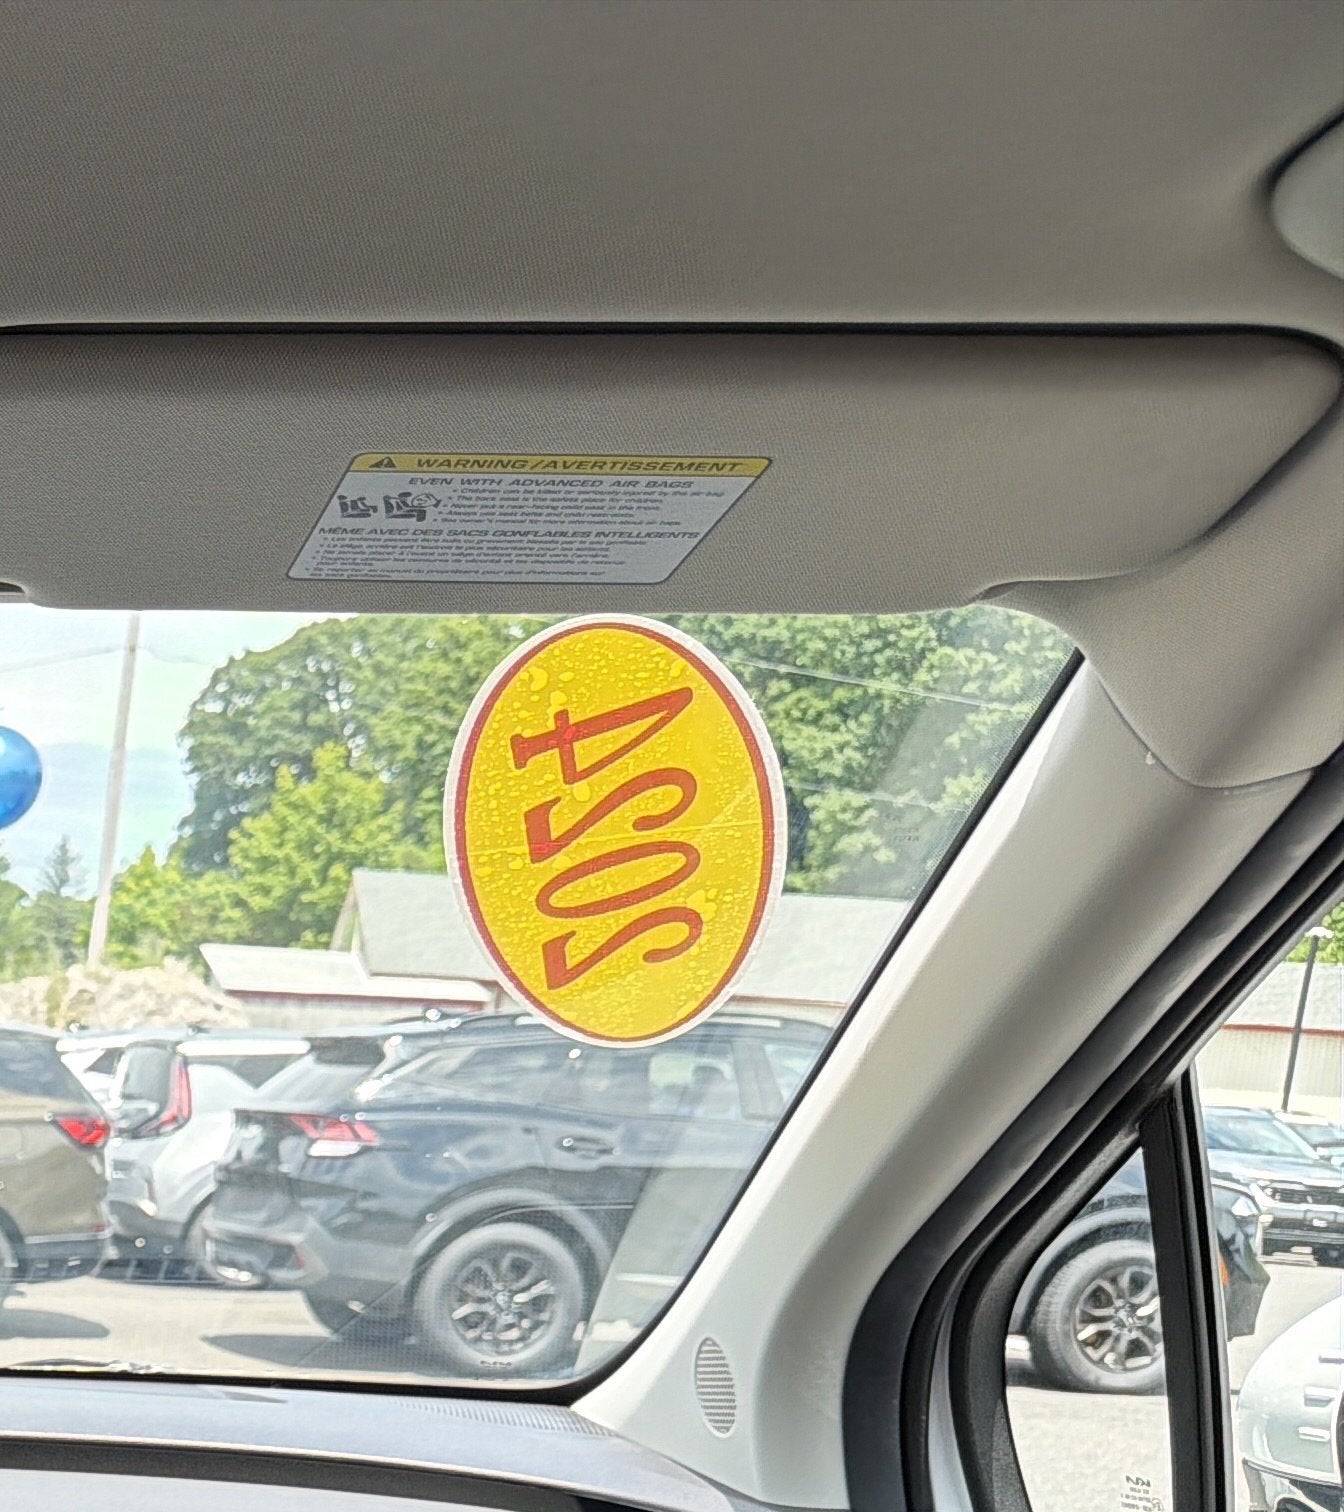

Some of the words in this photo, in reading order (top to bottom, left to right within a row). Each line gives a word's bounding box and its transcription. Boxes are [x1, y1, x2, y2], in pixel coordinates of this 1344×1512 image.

[417, 458, 524, 470] WARNING
[408, 478, 454, 486] EVEN
[508, 479, 604, 487] ADVANCED
[609, 480, 639, 488] AIR
[645, 481, 694, 489] BAGS
[368, 528, 409, 536] AVEC
[412, 529, 443, 537] DES
[446, 529, 489, 537] SACS
[594, 531, 700, 540] INTELLIGENTS
